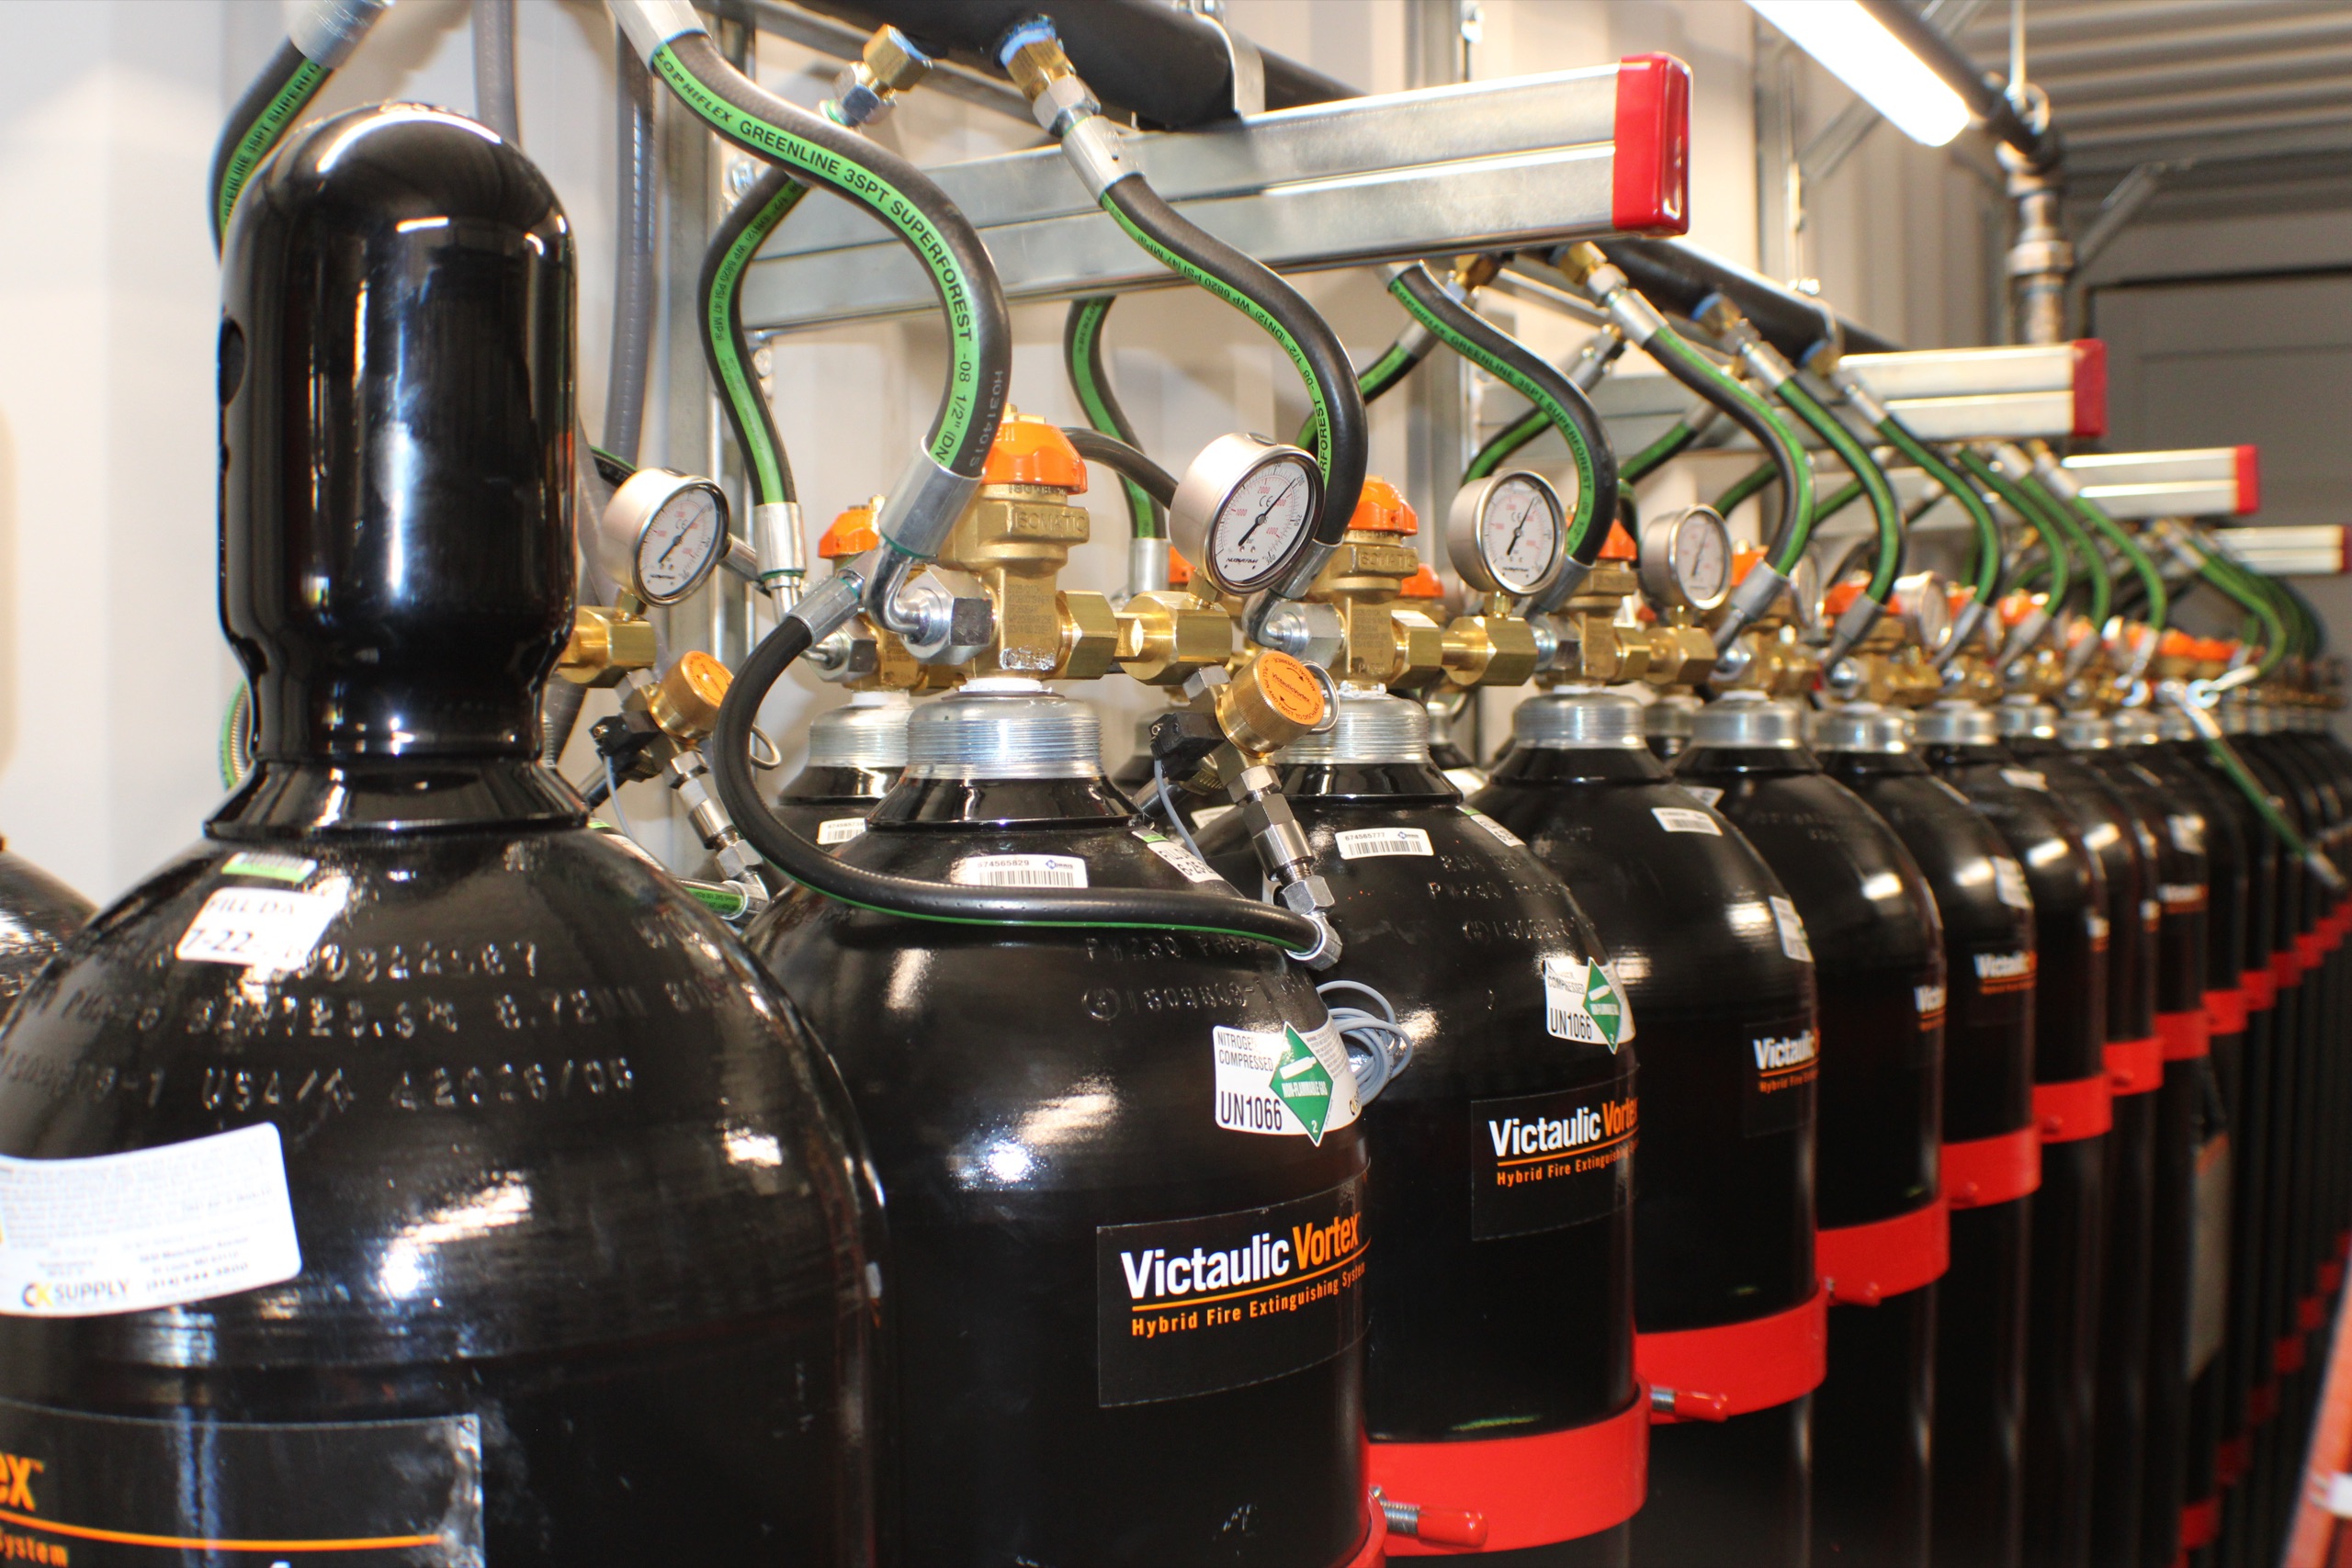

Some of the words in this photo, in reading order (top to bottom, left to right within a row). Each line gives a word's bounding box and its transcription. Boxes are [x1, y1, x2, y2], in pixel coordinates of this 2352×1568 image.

[684, 84, 733, 123] HIFLEX
[739, 120, 842, 176] GREENLINE
[843, 168, 890, 204] 3SPT
[889, 199, 973, 342] SUPERFOREST
[958, 353, 972, 384] -08
[1449, 334, 1516, 381] GREENLINE
[934, 429, 957, 466] (DN
[1013, 511, 1088, 533] ISOMATIC
[1216, 1031, 1258, 1051] NITROGE
[1550, 1007, 1592, 1040] UN1066
[1218, 1049, 1274, 1071] COMPRESSED
[1220, 1090, 1283, 1131] UN1066
[1311, 1119, 1318, 1134] 2
[1487, 1106, 1601, 1157] Victaulic
[1497, 1167, 1543, 1188] Hybrid
[1547, 1163, 1571, 1179] Fire
[1120, 1232, 1290, 1300] Victaulic
[1292, 1212, 1360, 1270] Vortex
[54, 1278, 129, 1303] SUPPLY
[1131, 1311, 1198, 1339] Hybrid
[1206, 1306, 1241, 1327] Fire
[1250, 1276, 1340, 1318] Extinguishing
